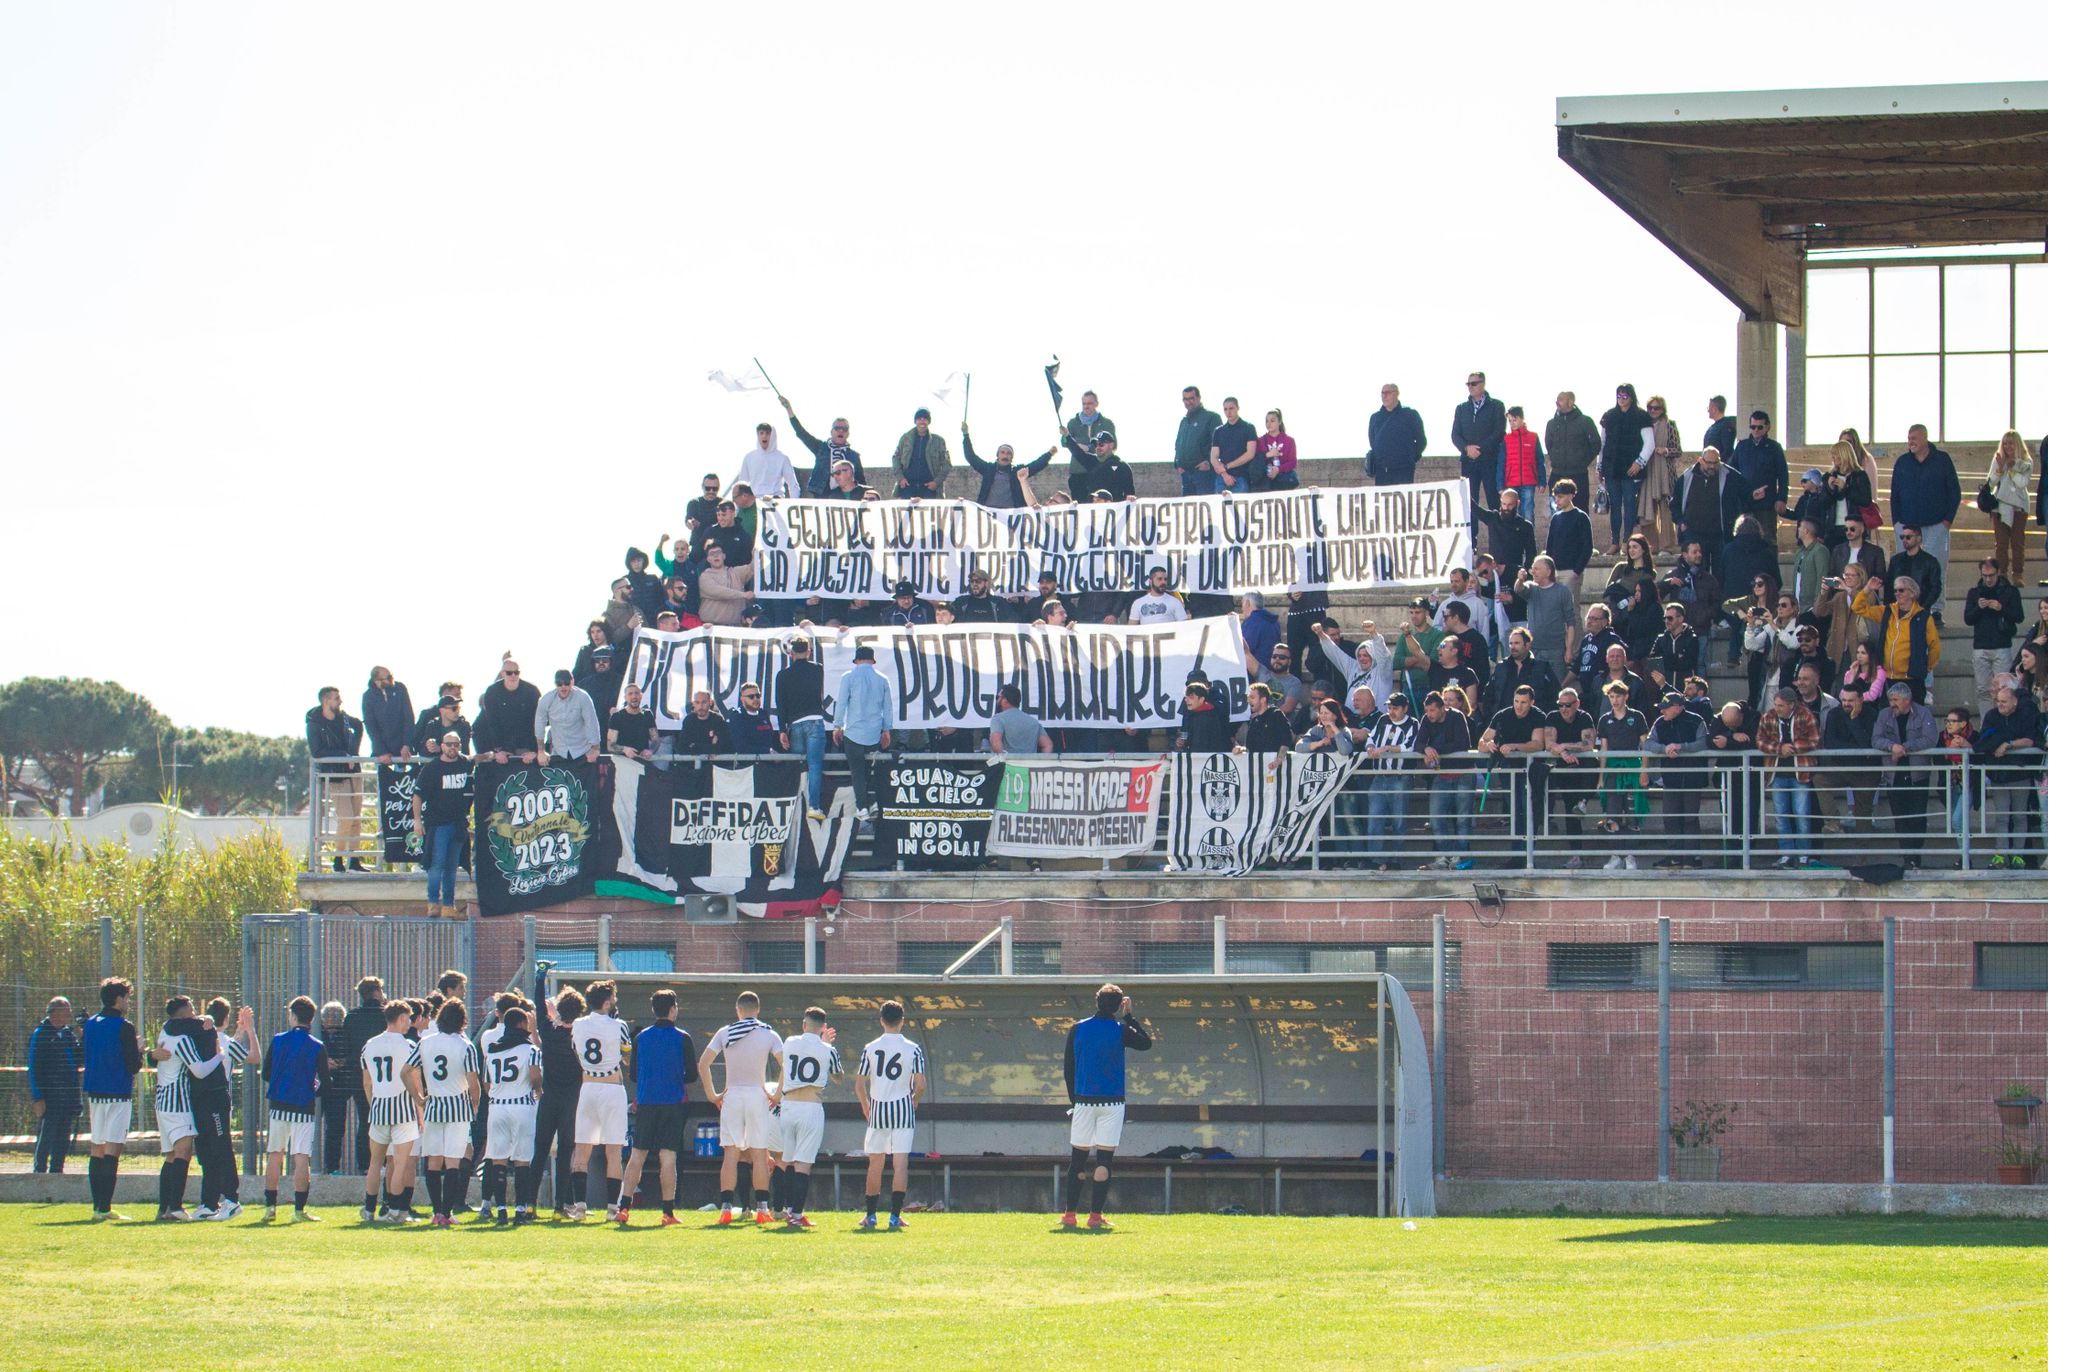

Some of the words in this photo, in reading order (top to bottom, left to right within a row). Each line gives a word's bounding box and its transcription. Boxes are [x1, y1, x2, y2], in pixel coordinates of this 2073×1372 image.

[1089, 509, 1116, 548] LA
[1126, 502, 1213, 546] NOSTRA
[1222, 494, 1327, 543] COSTANTE
[890, 768, 985, 787] SGUARDO
[1003, 772, 1024, 805] 19
[1030, 770, 1084, 811] MASSA
[1088, 771, 1130, 811] KAOS
[1203, 770, 1237, 783] MASSESE
[507, 787, 569, 826] 2003
[895, 787, 919, 803] AL
[926, 786, 983, 805] CIELO,
[910, 822, 962, 839] NODO
[998, 814, 1085, 846] ALESSANDRO
[1088, 815, 1149, 846] PRESENT
[515, 833, 572, 870] 2023
[897, 838, 917, 855] IN
[922, 839, 980, 856] GOLA!
[585, 1037, 604, 1065] 8
[874, 1049, 902, 1081] 16
[373, 1056, 393, 1082] 11
[432, 1054, 448, 1081] 3
[491, 1055, 519, 1084] 15
[788, 1054, 821, 1083] 10
